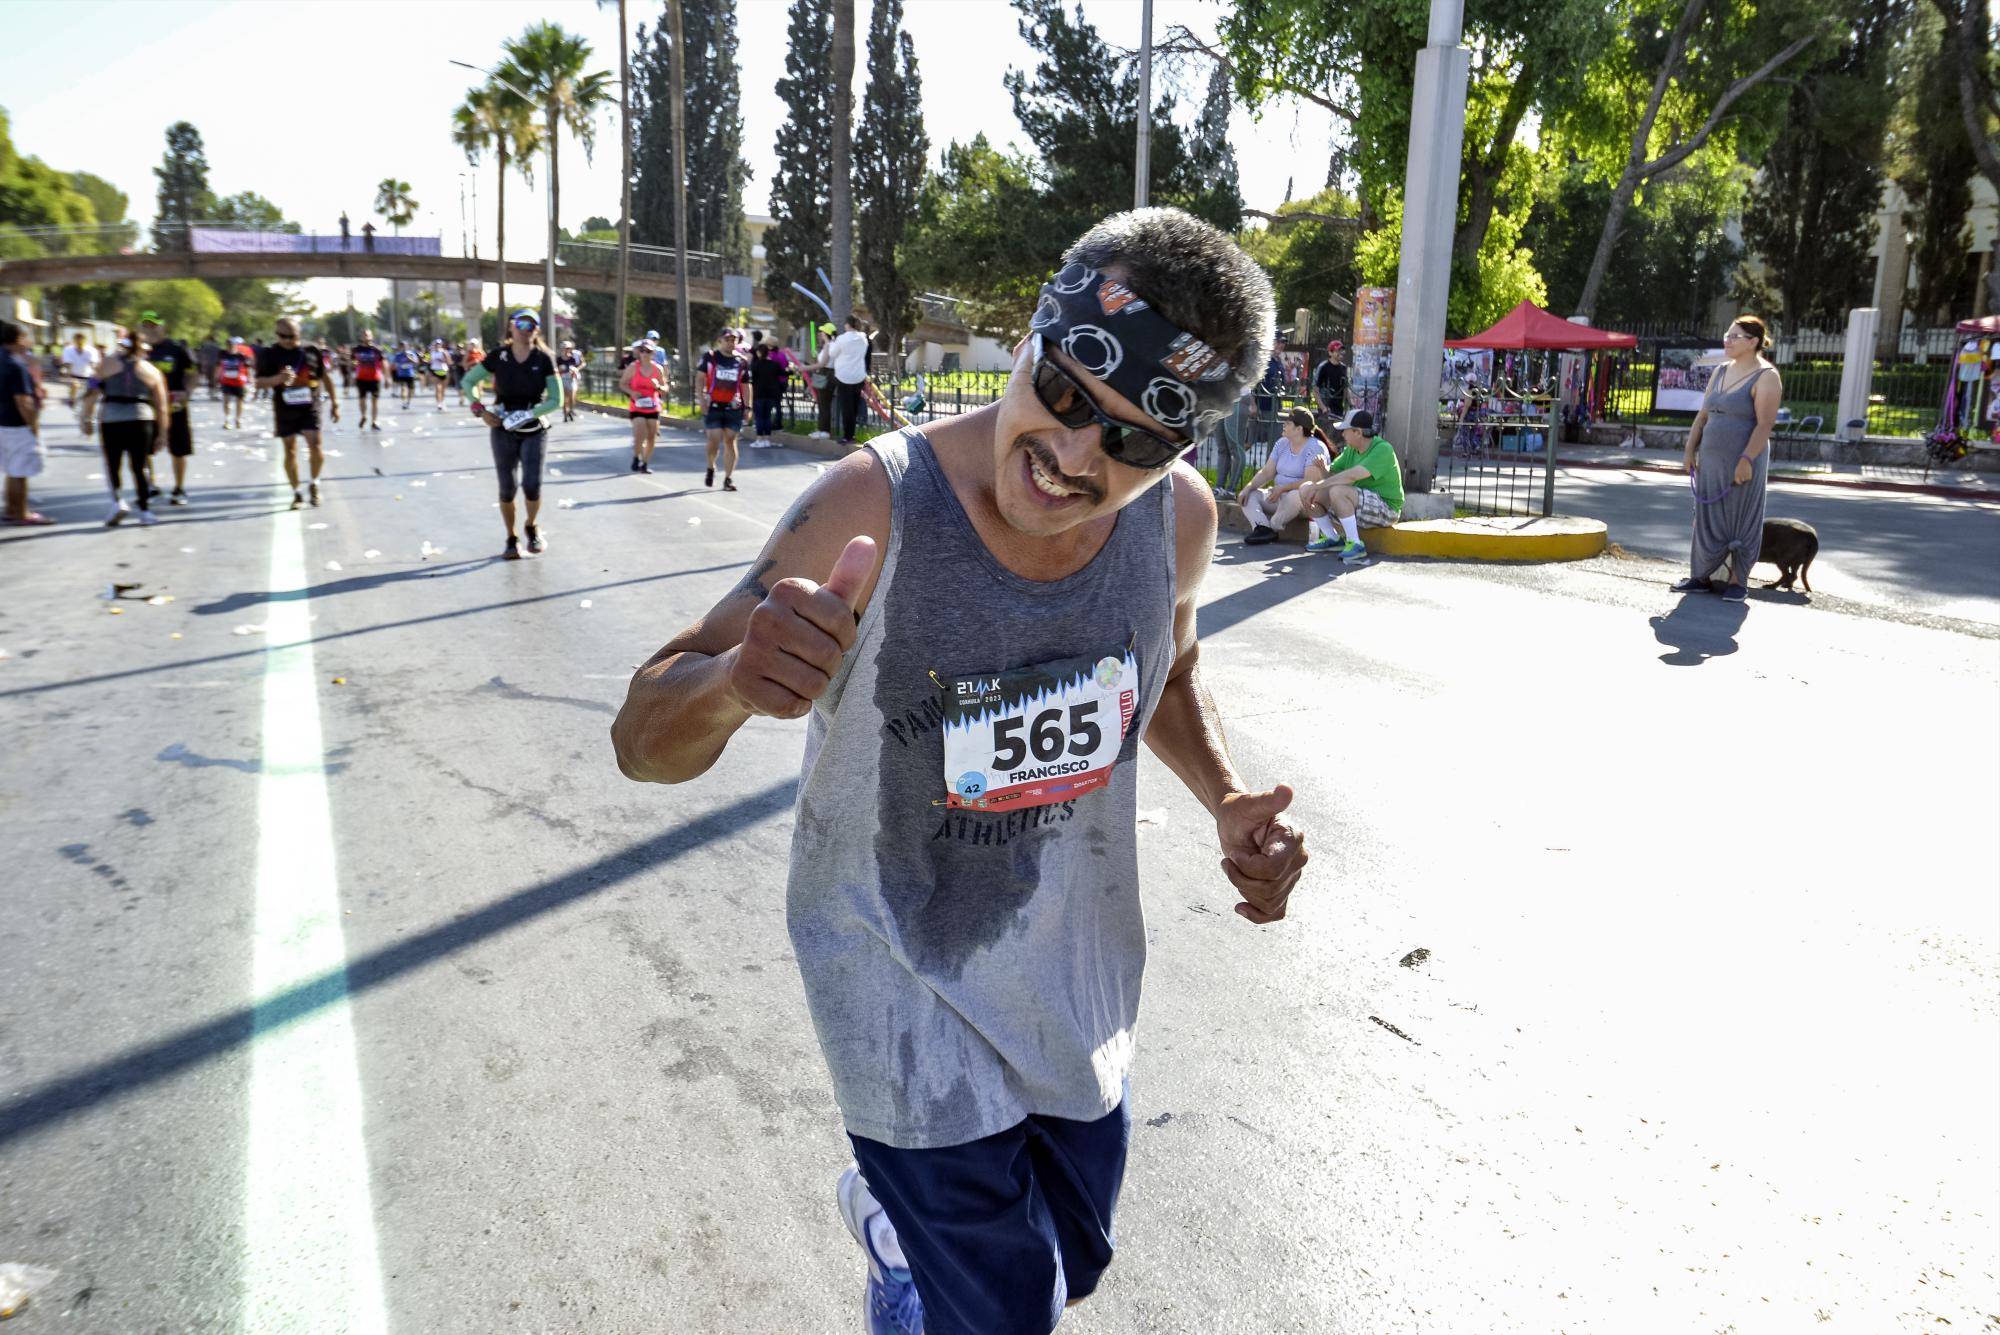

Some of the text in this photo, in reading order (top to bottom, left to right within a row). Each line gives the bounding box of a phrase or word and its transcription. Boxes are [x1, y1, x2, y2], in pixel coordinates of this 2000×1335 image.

[985, 694, 1001, 703] 2023
[991, 700, 1102, 771] 565
[1009, 759, 1089, 784] FRANCISCO
[964, 783, 981, 795] 42
